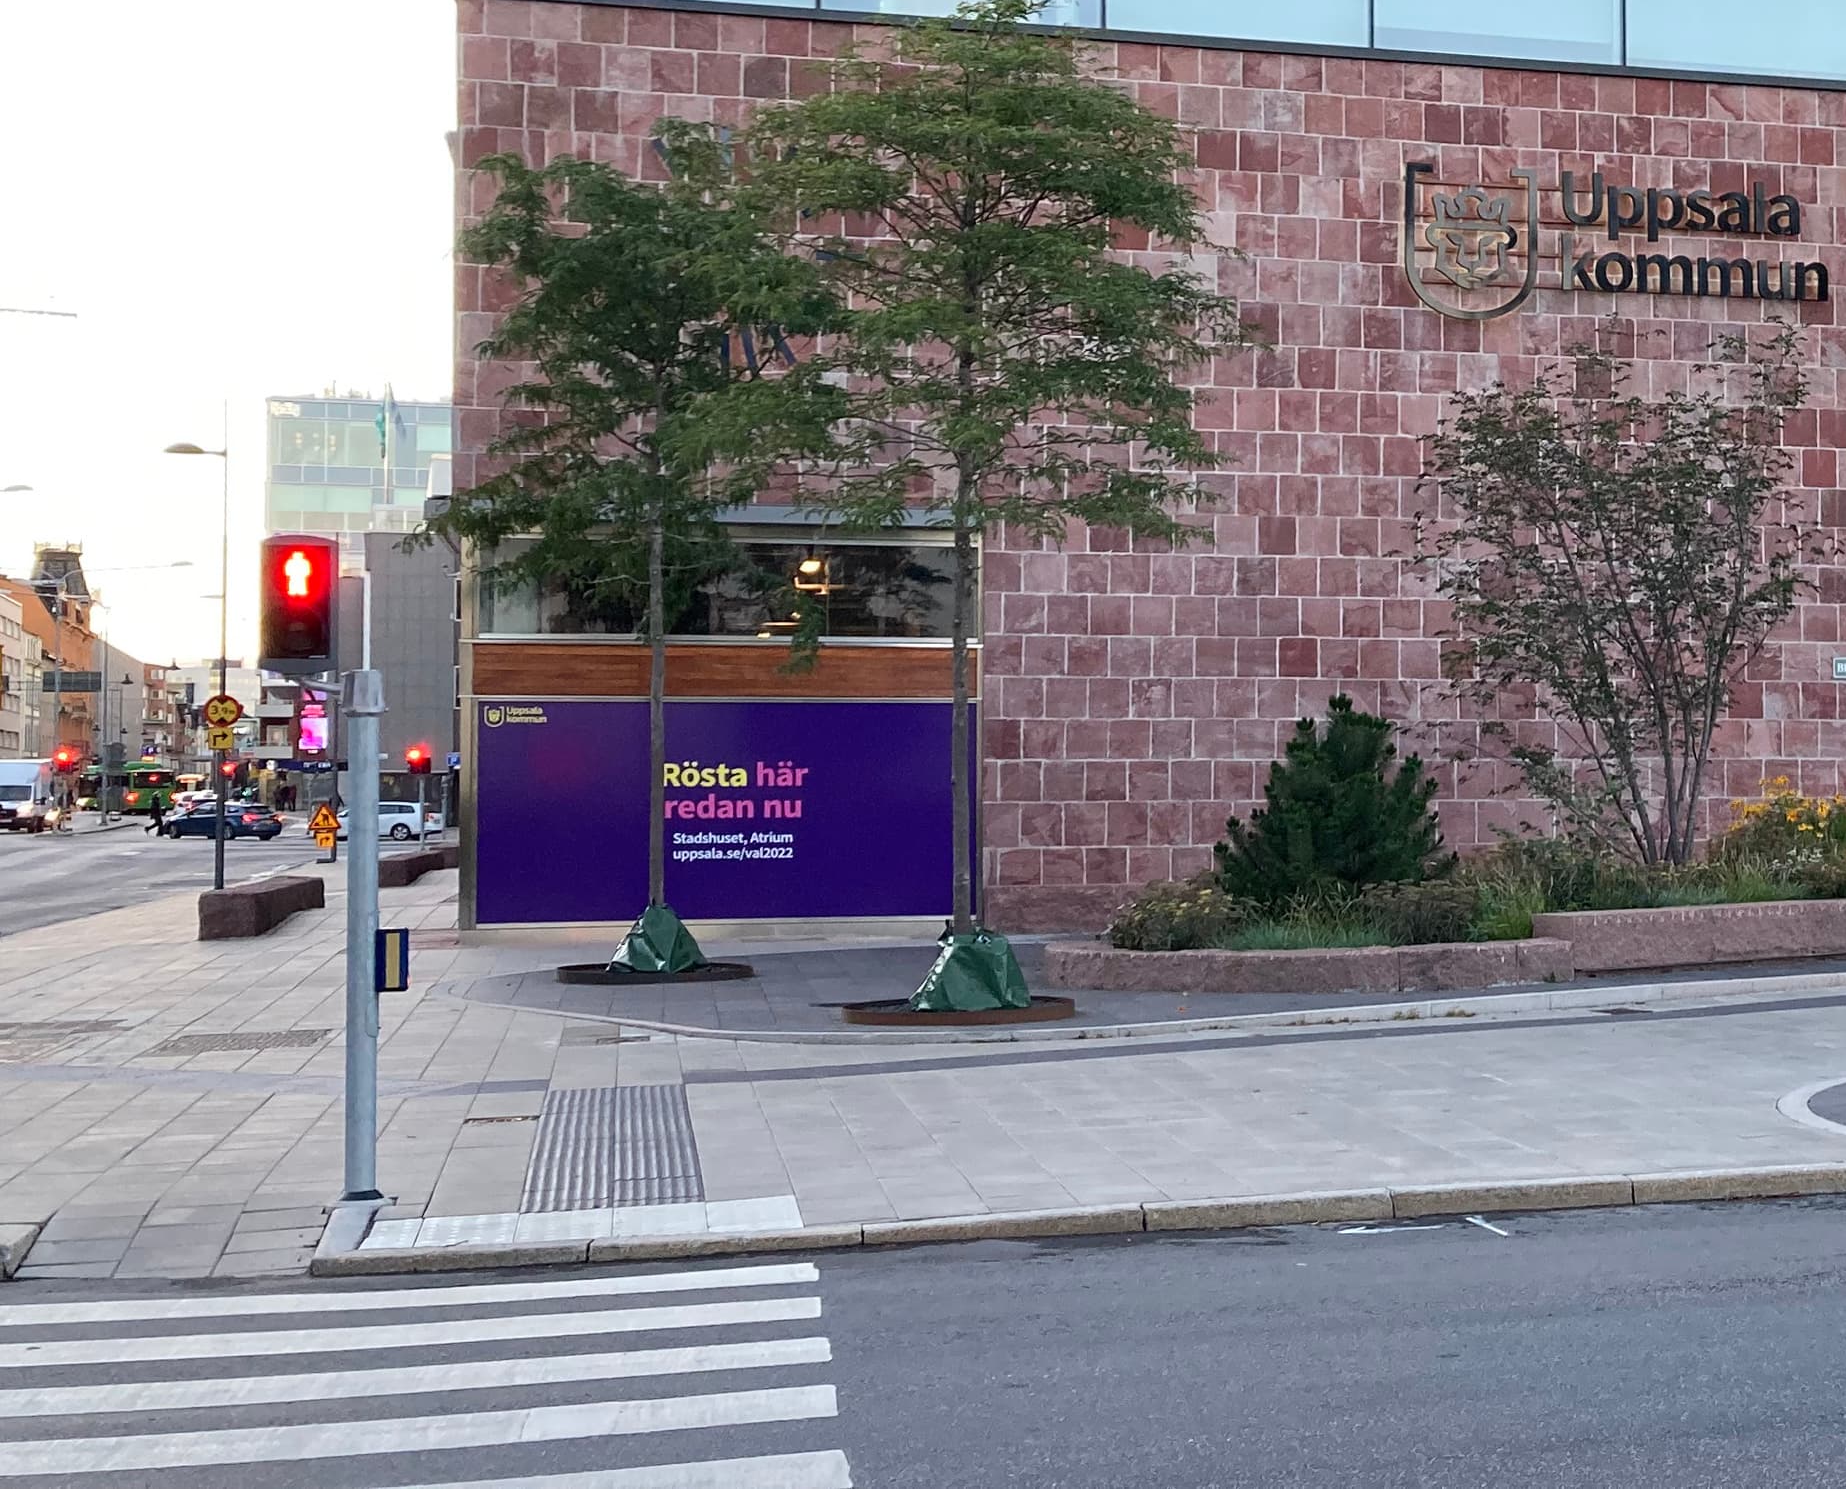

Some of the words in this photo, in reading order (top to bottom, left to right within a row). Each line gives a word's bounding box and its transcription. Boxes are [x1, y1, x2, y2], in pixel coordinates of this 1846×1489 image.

[1560, 171, 1801, 241] Uppsala
[1560, 233, 1829, 302] kommun
[506, 706, 543, 715] Uppsala
[663, 761, 748, 787] Rösta
[756, 761, 809, 787] här
[664, 793, 754, 819] redan
[763, 800, 803, 818] nu
[673, 832, 748, 845] Stadshuset,
[750, 832, 794, 844] Atrium
[673, 847, 794, 862] uppsala.se/val2022
